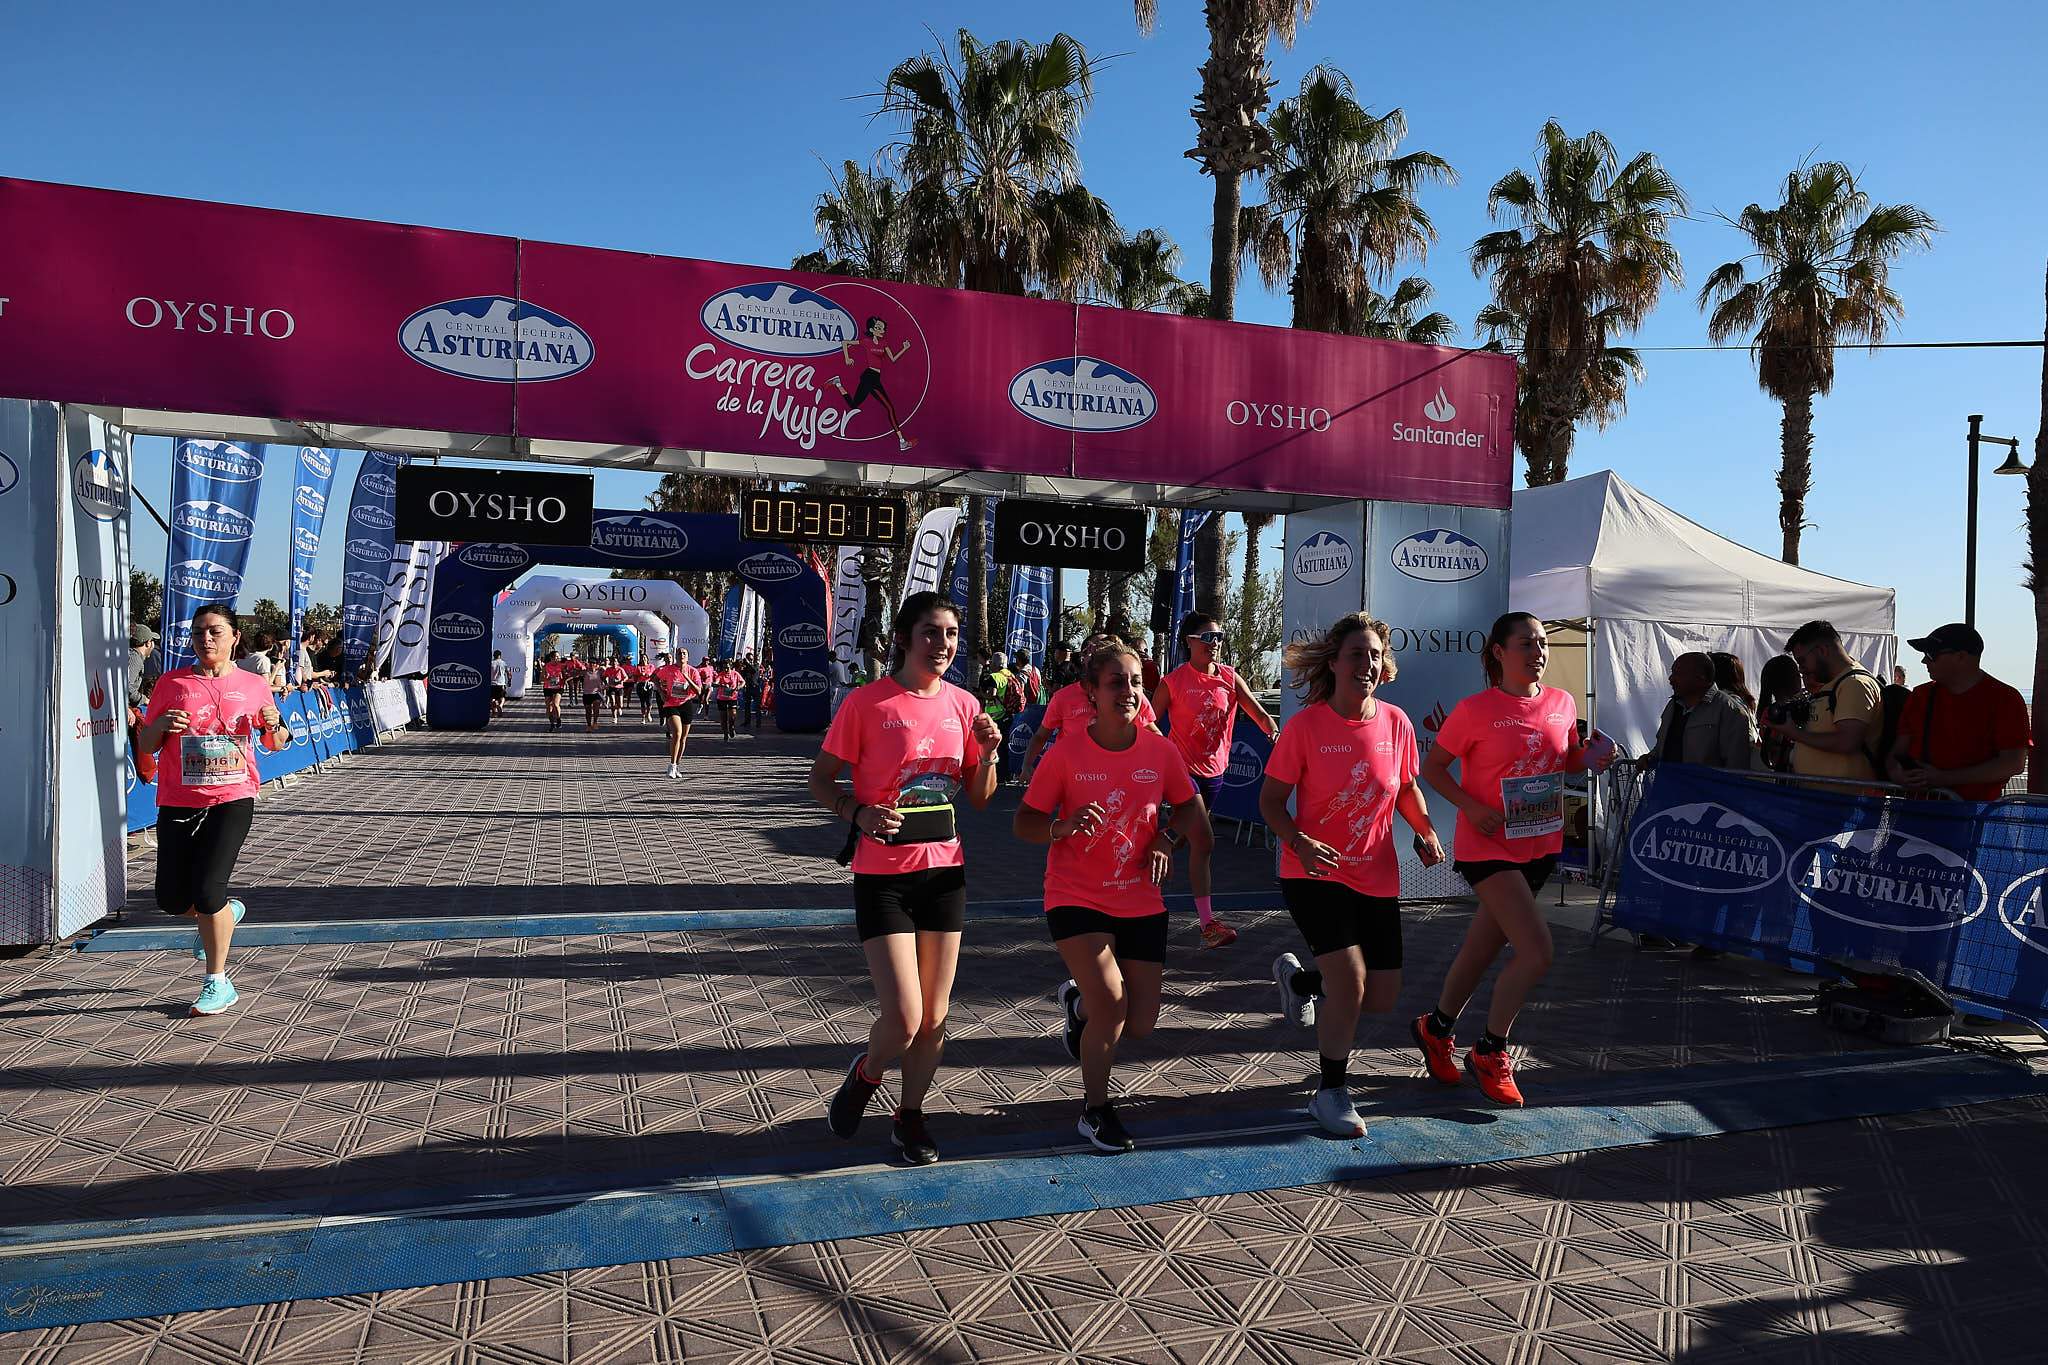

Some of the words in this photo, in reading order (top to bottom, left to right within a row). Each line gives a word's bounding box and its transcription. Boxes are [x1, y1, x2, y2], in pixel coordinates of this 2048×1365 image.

[125, 296, 295, 339] OYSHO
[713, 302, 846, 342] ASTURIANA
[738, 303, 788, 315] CENTRAL
[792, 309, 842, 321] LECHERA
[445, 321, 507, 335] CENTRAL
[414, 321, 580, 365] ASTURIANA
[685, 343, 816, 390] Carrera
[1020, 379, 1146, 416] ASTURIANA
[1044, 379, 1090, 390] CENTRAL
[1095, 383, 1142, 395] LECHERA
[716, 387, 741, 412] de
[746, 386, 764, 415] la
[759, 389, 861, 450] Mujer
[1226, 400, 1331, 432] OYSHO
[1392, 423, 1485, 448] Santander
[181, 447, 257, 477] ASTURIANA
[77, 469, 122, 507] ASTURIANA
[362, 477, 396, 494] ASTURIAN
[355, 510, 393, 526] ASTURIANA
[429, 490, 567, 523] OYSHO
[174, 510, 250, 537] ASTURIANA
[752, 499, 895, 539] 00:38:13
[591, 527, 681, 550] ASTURIANA
[1019, 521, 1126, 551] OYSHO
[348, 544, 388, 559] ASTURIANA
[463, 549, 523, 564] ASTURIANA
[1398, 546, 1481, 571] ASTURIANA
[743, 562, 798, 575] ASTURIANA
[1295, 554, 1348, 575] ASTURIANA
[73, 575, 124, 610] OYSHO
[170, 569, 239, 593] ASTURIANA
[562, 583, 647, 603] OYSHO
[669, 603, 696, 611] OYSHO
[432, 625, 481, 635] ASTURIANA
[497, 632, 522, 640] OYSHO
[781, 633, 826, 643] ASTURIAN
[1389, 628, 1486, 654] OYSHO
[431, 673, 478, 685] ASTURIANA
[783, 680, 827, 691] ASTURIAN
[75, 717, 120, 740] Santander
[882, 719, 918, 729] OYSHO
[1493, 719, 1525, 729] OYSHO
[1320, 745, 1352, 753] OYSHO
[1074, 773, 1107, 781] OYSHO
[1665, 826, 1713, 841] CENTRAL
[1717, 836, 1769, 851] LECHERA
[1638, 826, 1769, 879] ASTURIANA
[1831, 853, 1892, 873] CENTRAL
[1899, 865, 1967, 883] LECHERA
[1798, 851, 1967, 915] ASTURIANA
